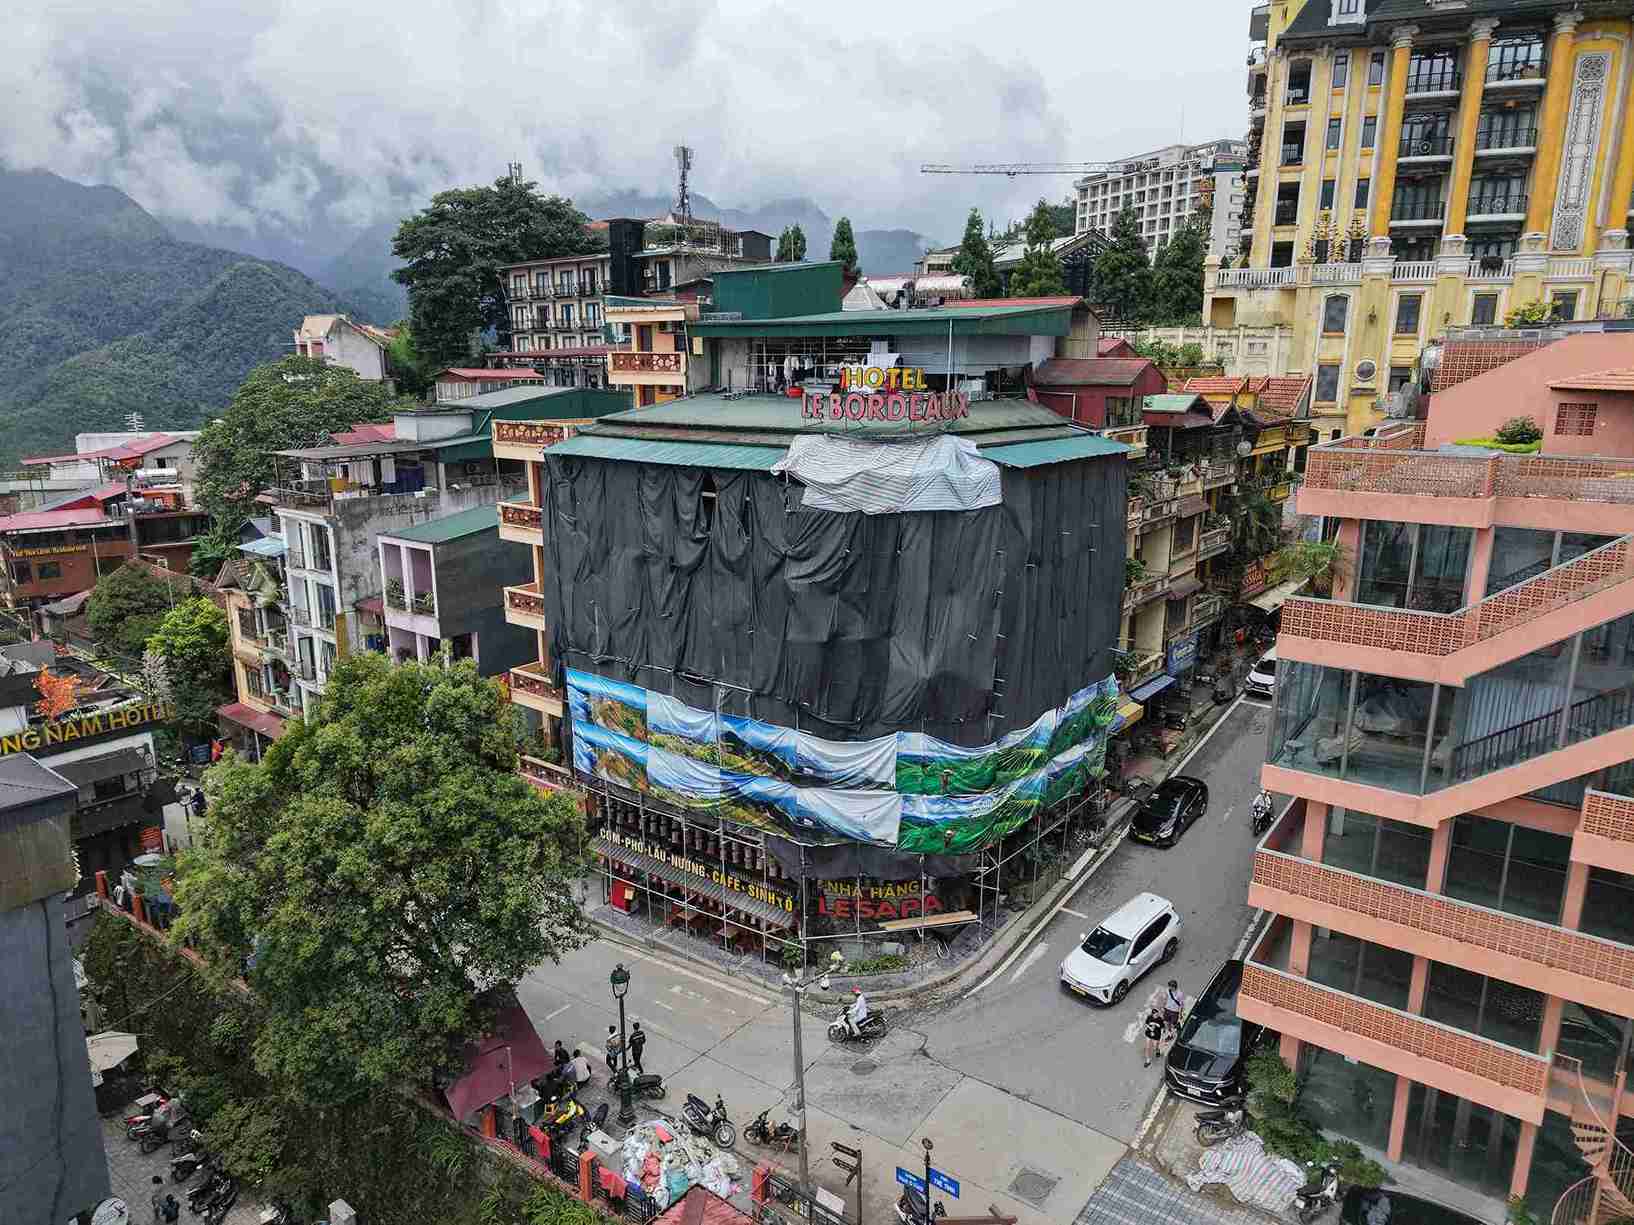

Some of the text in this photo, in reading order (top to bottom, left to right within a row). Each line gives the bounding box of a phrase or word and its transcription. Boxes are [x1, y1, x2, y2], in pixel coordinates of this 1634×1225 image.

[840, 367, 928, 391] HOTEL
[801, 391, 970, 421] LE BORDEAUX
[46, 714, 103, 745] NAM
